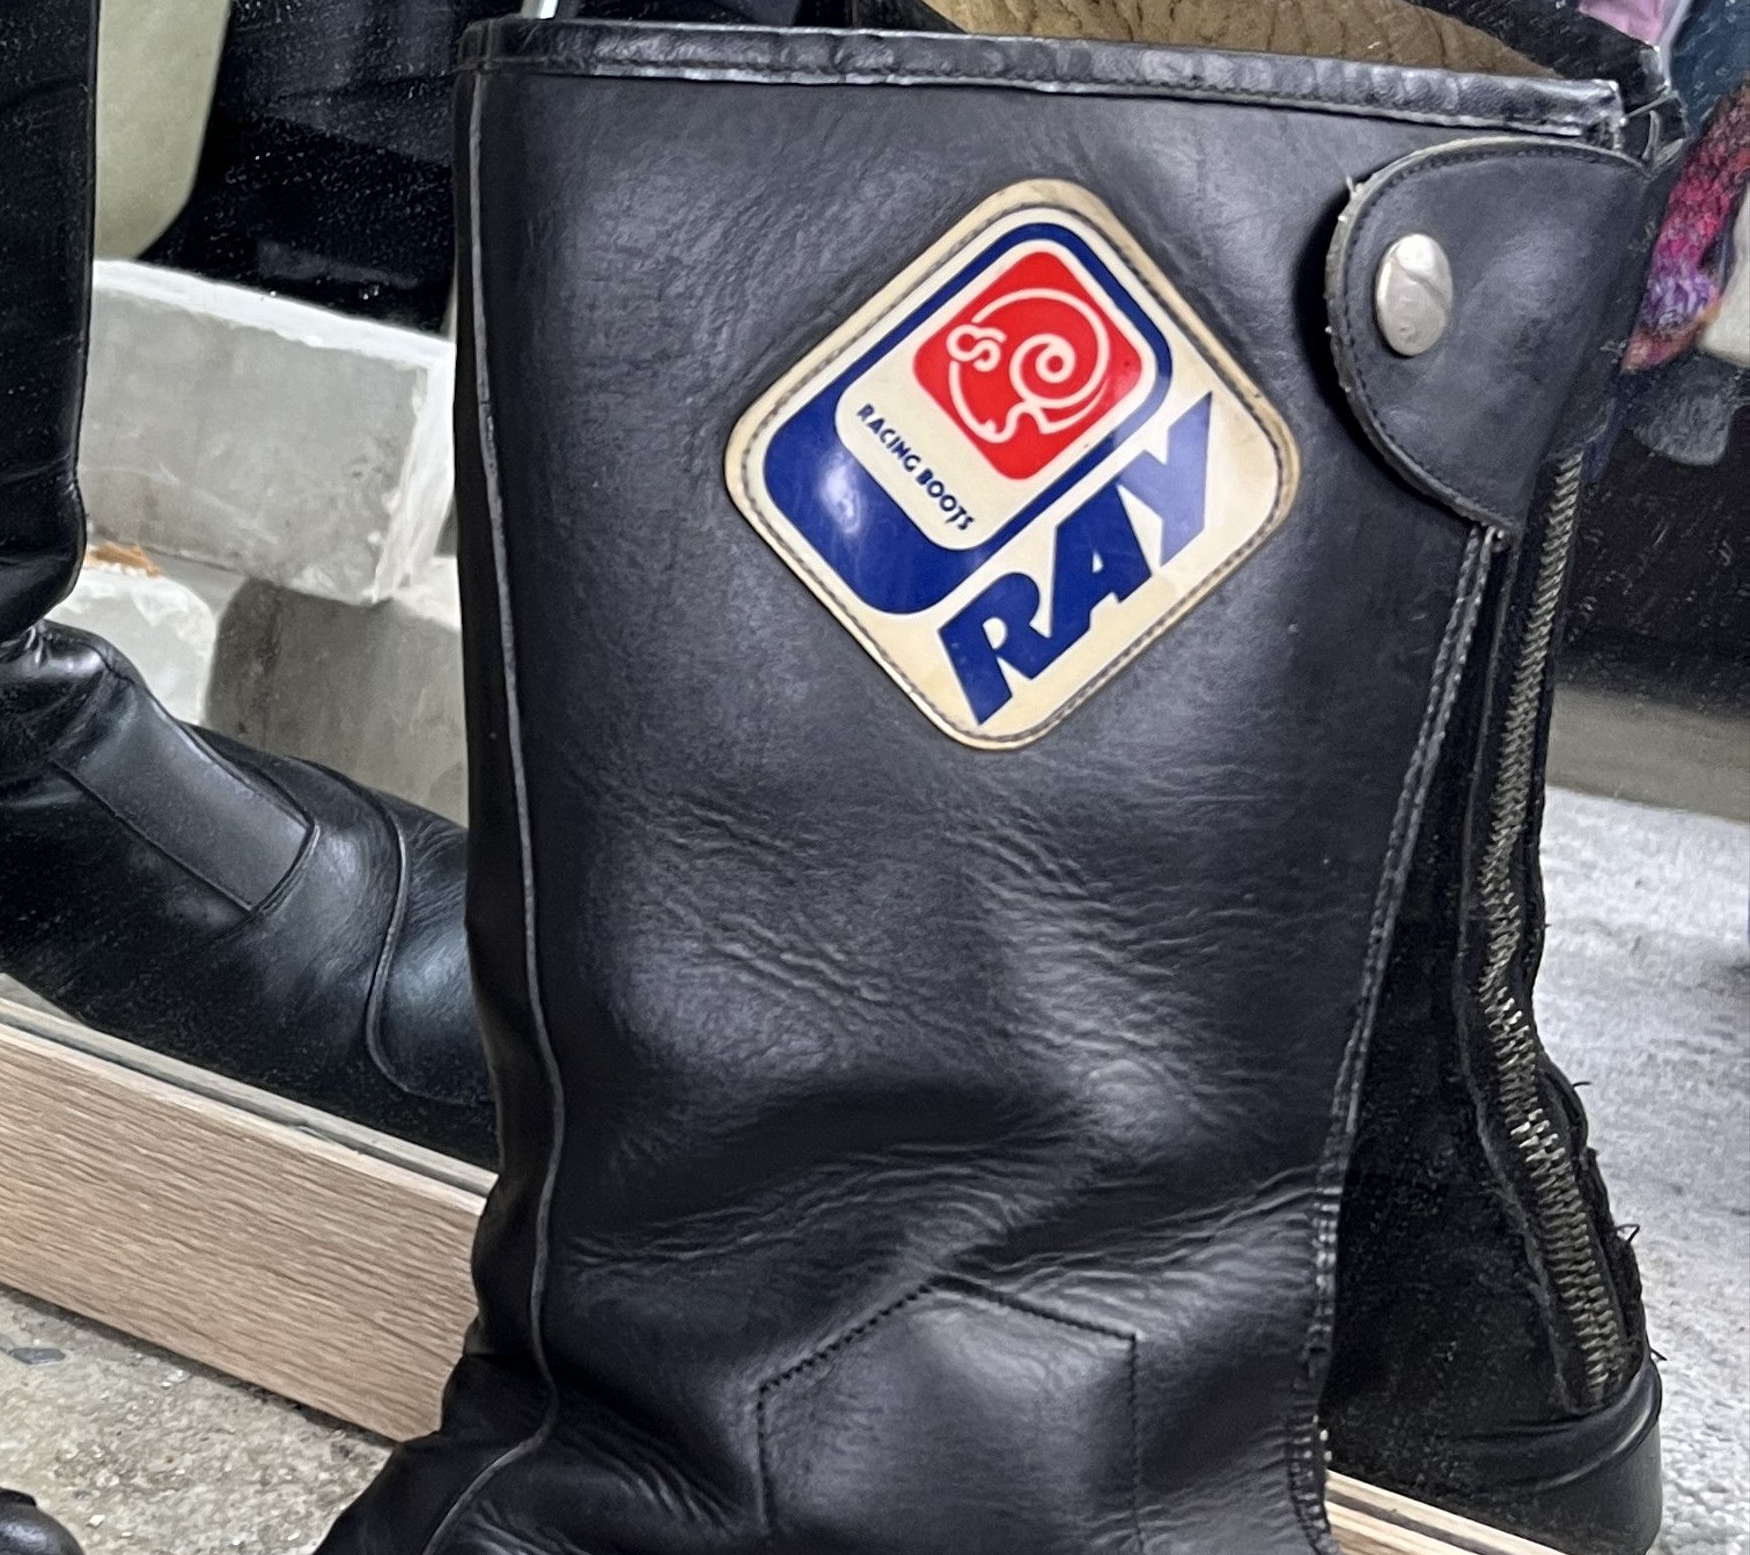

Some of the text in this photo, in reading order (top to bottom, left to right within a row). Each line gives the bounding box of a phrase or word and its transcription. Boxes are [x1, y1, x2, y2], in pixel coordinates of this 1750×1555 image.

[856, 402, 974, 530] RACING BOOTS
[938, 390, 1212, 726] RAY
